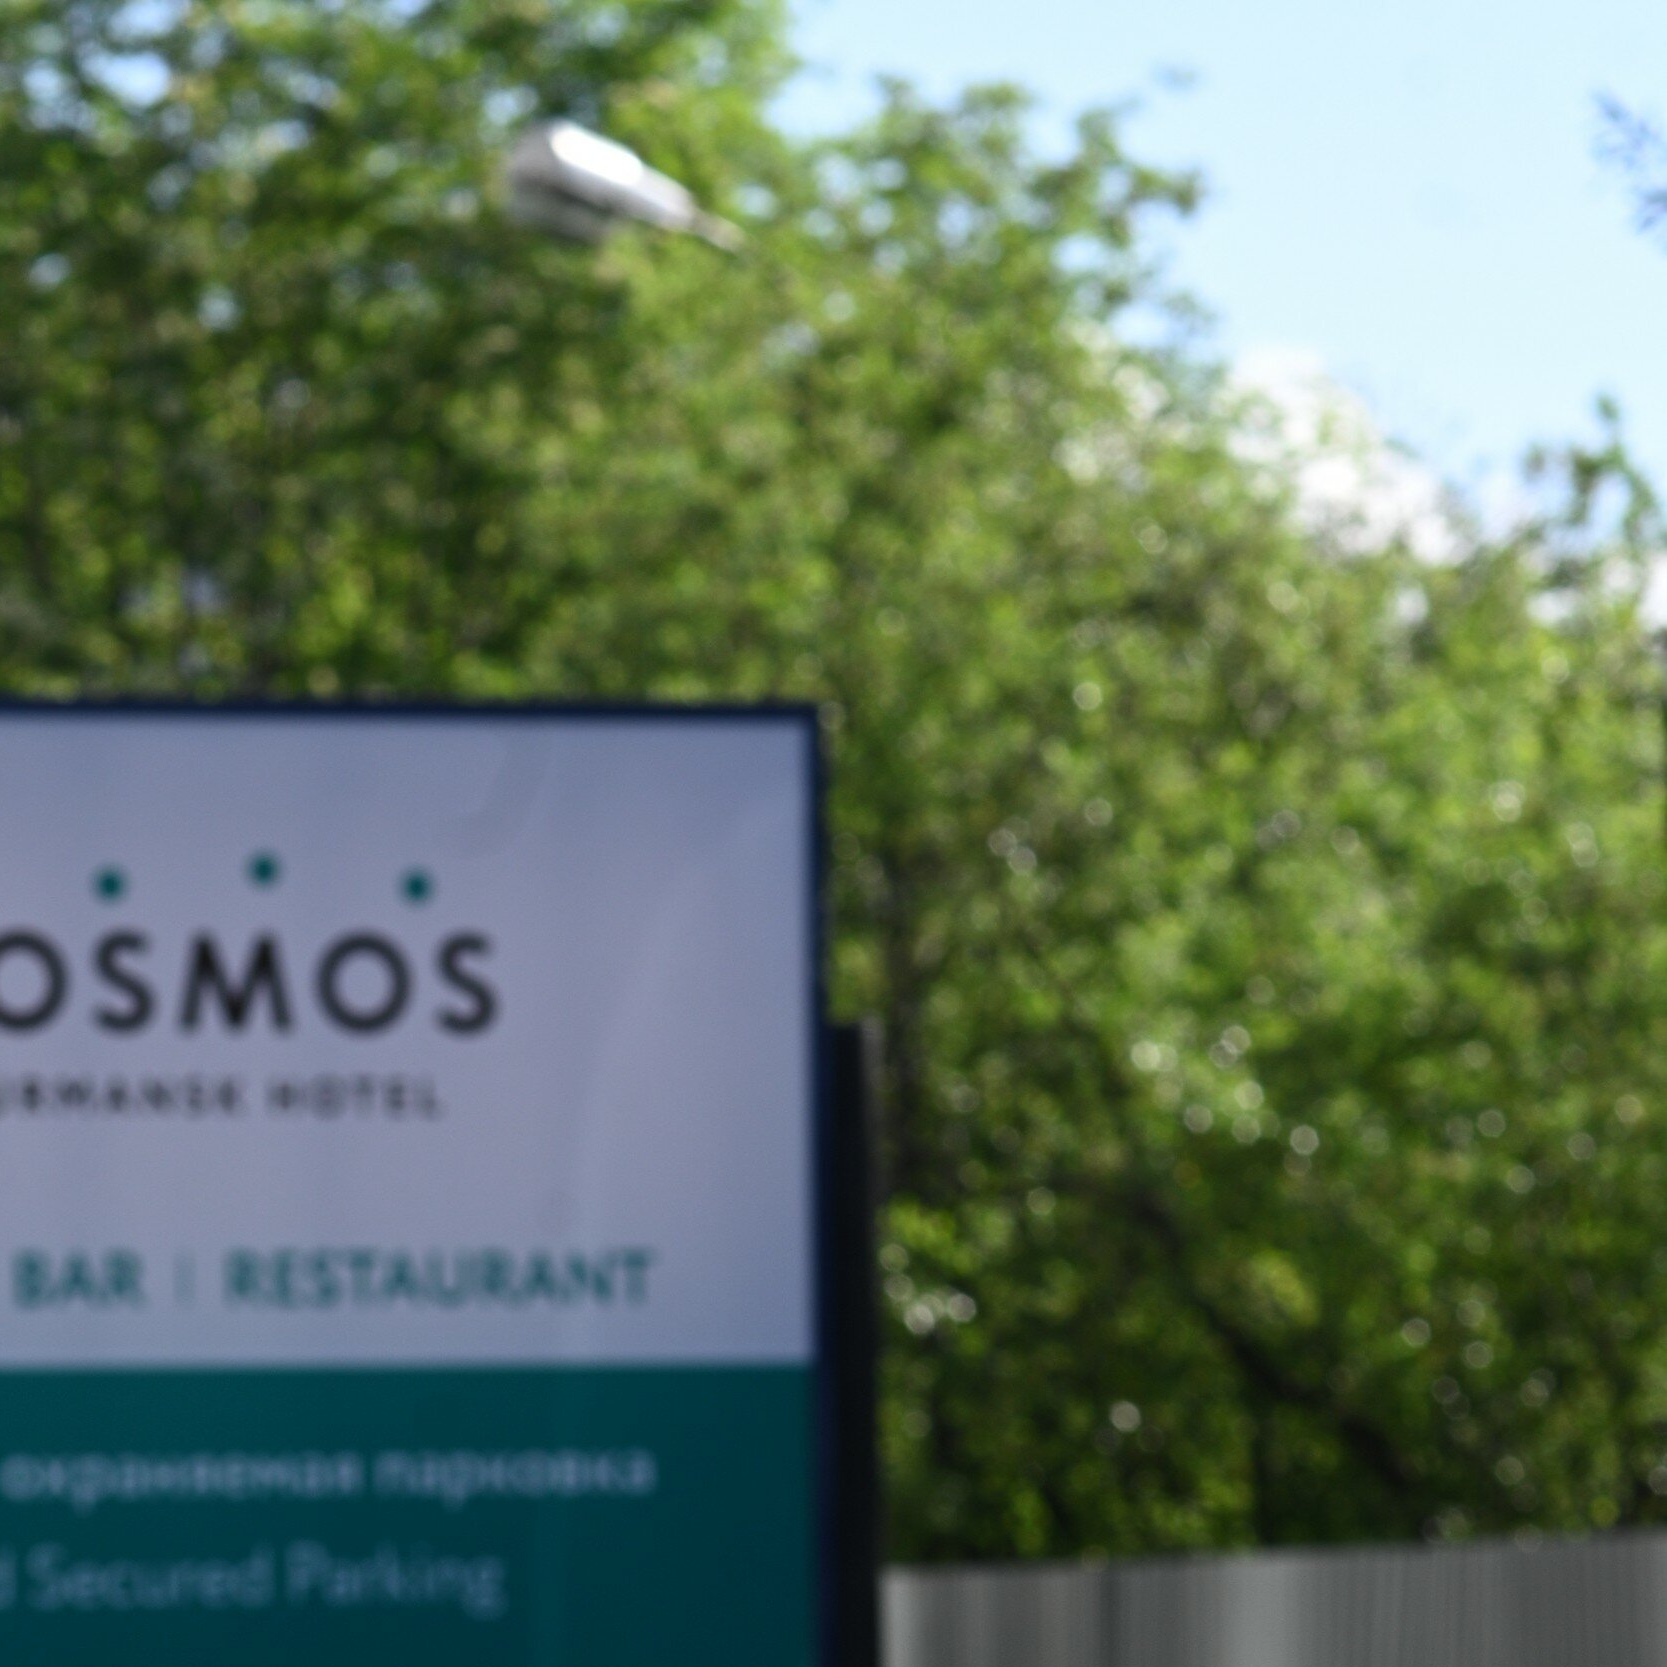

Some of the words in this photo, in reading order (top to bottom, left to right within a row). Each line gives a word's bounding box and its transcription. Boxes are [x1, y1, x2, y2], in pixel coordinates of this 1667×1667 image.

[271, 1075, 444, 1118] HOTEL
[13, 1249, 146, 1309] BAR
[224, 1249, 656, 1309] RESTAURANT
[0, 1453, 362, 1511] охраняемая
[376, 1451, 656, 1507] парковка
[31, 1545, 273, 1609] Secured
[287, 1543, 505, 1617] Parking
